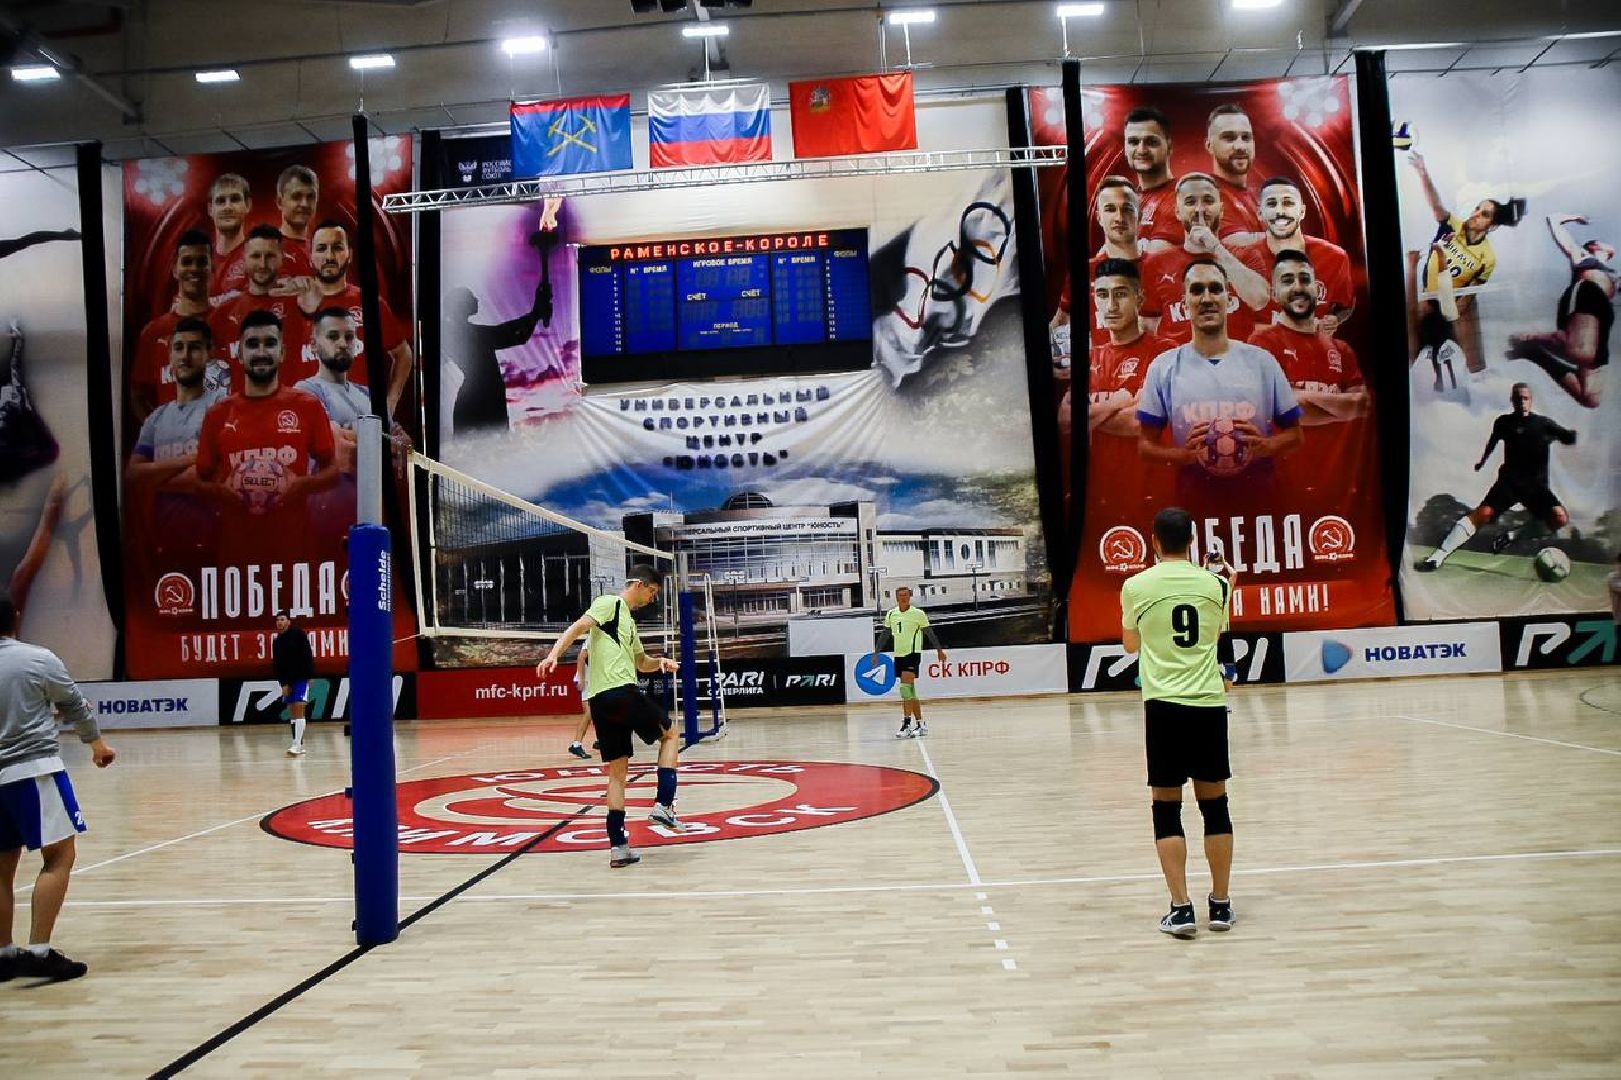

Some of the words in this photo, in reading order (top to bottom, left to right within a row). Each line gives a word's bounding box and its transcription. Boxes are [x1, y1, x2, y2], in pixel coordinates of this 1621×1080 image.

[610, 234, 829, 260] РАМЕНСКОЕ-КОРОЛЕ
[620, 386, 830, 411] УНИВЕРСАЛЬНЫЙ
[643, 407, 807, 431] СПОРТИВНЫЙ
[201, 561, 336, 620] ПОБЕДА
[378, 549, 387, 611] Schelde
[1260, 583, 1330, 616] НАМИ!
[896, 621, 902, 634] 1
[1172, 604, 1199, 648] 9
[181, 634, 241, 663] БУДЕТ
[1365, 643, 1467, 662] НОВАТЭК
[714, 671, 765, 687] PARI
[928, 663, 952, 678] СК
[958, 661, 1010, 677] КПРФ
[475, 682, 568, 701] mfc-kprf.ru
[98, 698, 188, 714] НОВАТЭК
